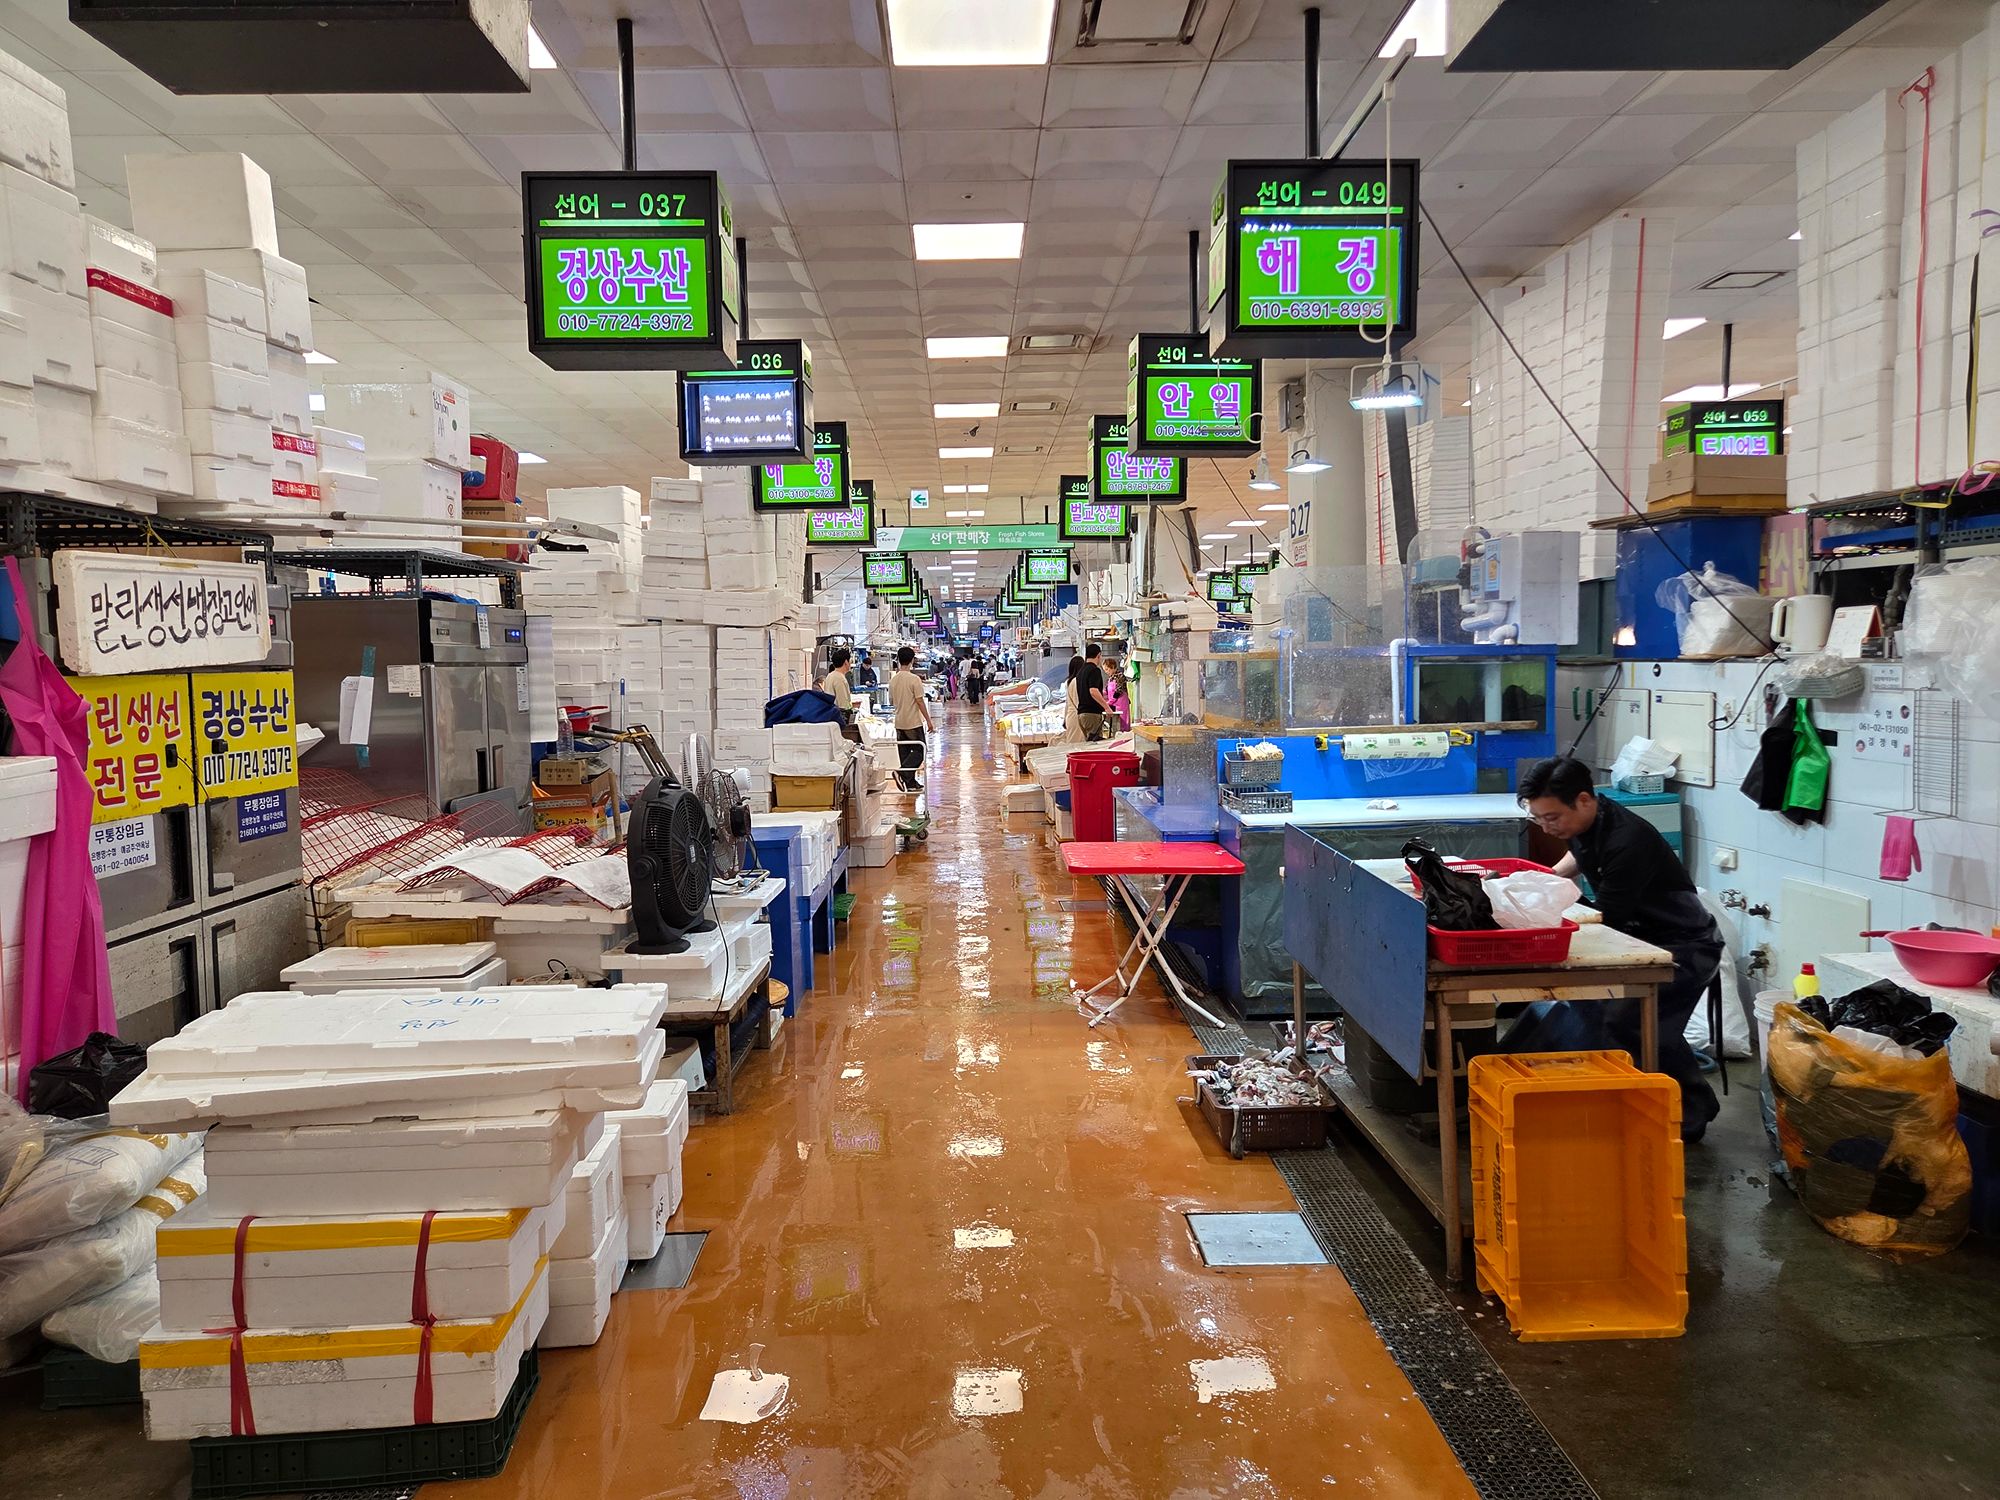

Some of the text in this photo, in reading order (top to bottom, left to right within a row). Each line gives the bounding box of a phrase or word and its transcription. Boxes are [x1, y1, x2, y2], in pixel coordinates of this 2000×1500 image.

[1256, 181, 1301, 207] 선어
[1339, 181, 1386, 205] 049
[554, 193, 600, 218] 선어
[639, 194, 687, 217] 037
[558, 248, 690, 303] 경상수산
[1250, 302, 1384, 319] 010-6391-8995
[558, 313, 693, 331] 010-7724-3972
[751, 354, 783, 369] 036
[1157, 346, 1186, 363] 선어
[1703, 411, 1726, 424] 선어
[1743, 410, 1768, 422] 059
[813, 433, 832, 444] 35
[1108, 425, 1128, 437] 선어
[850, 487, 863, 496] 34
[1071, 482, 1088, 492] 선어
[930, 532, 952, 545] 선어
[956, 531, 990, 545] 판매장
[80, 690, 182, 745] 린생선
[202, 688, 289, 739] 경상수산
[204, 747, 292, 786] 010 7724 3972
[93, 753, 162, 806] 전문
[244, 795, 280, 812] 무통장입금
[95, 822, 144, 844] 무통장입금
